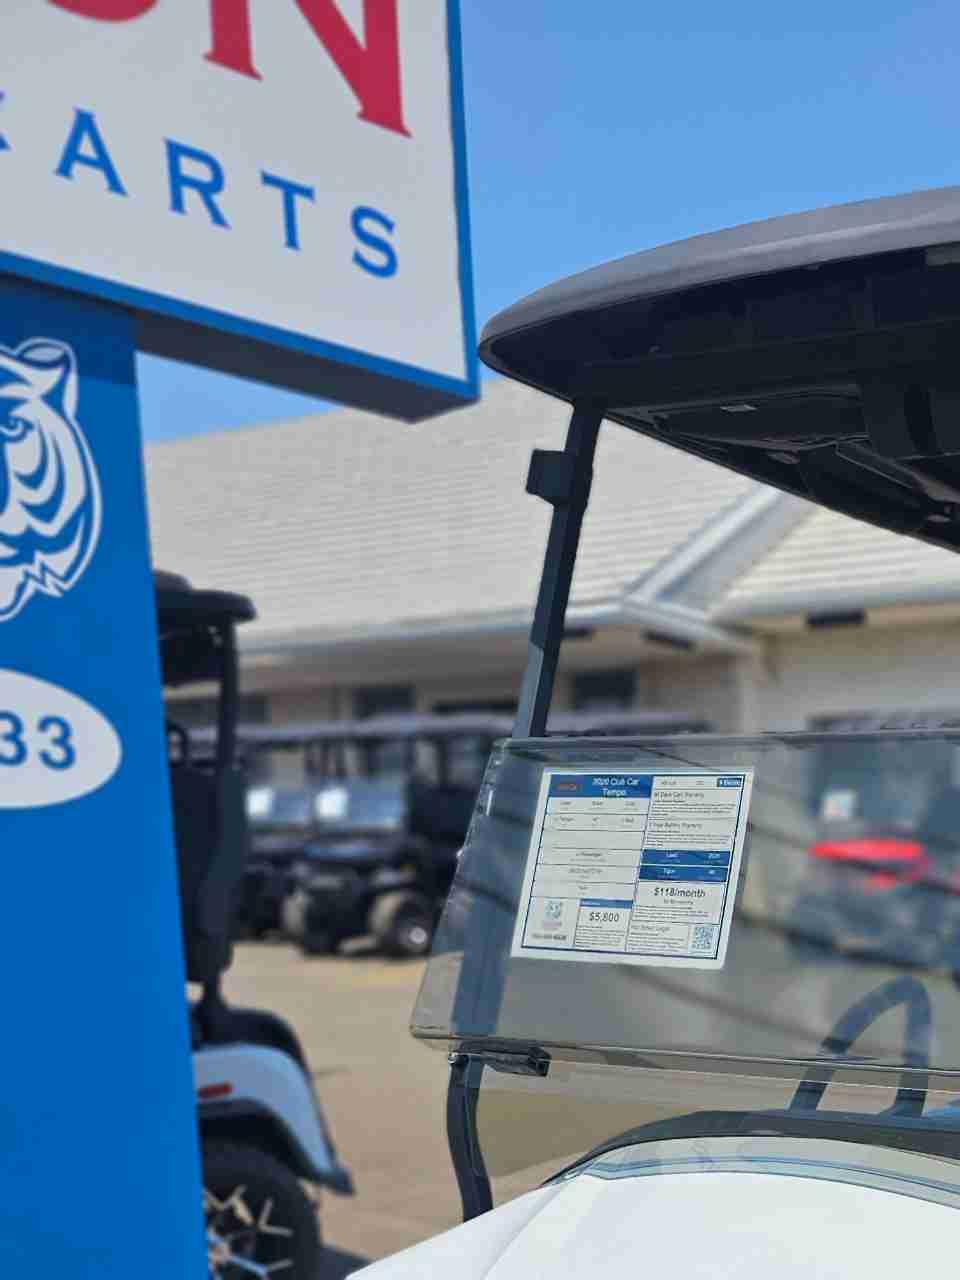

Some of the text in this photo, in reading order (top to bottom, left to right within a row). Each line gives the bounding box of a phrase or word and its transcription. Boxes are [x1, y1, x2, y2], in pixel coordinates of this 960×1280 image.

[0, 91, 399, 280] ARTS
[610, 777, 626, 786] Club
[627, 777, 640, 786] Car
